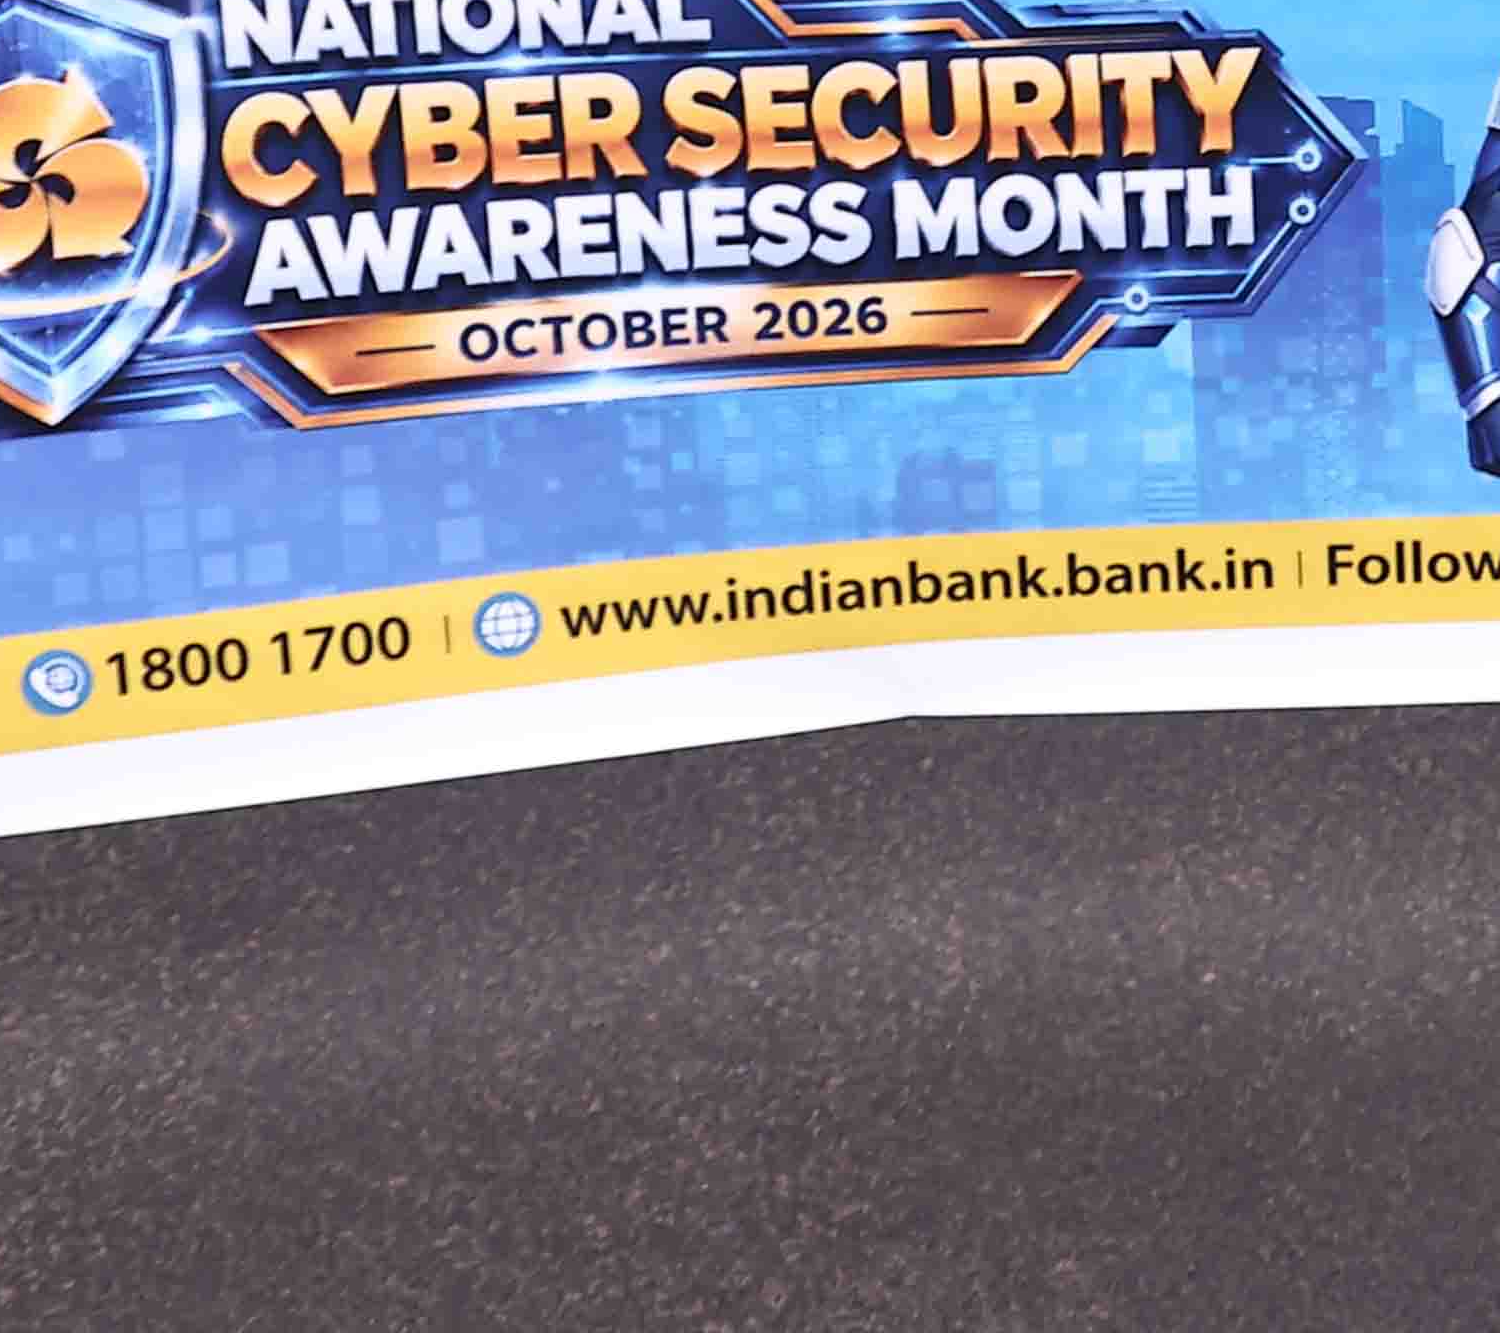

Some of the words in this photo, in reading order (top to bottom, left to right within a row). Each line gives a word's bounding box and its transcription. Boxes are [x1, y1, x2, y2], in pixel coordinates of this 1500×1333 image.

[221, 70, 647, 210] CYBER
[662, 46, 1263, 176] SECURITY
[243, 178, 873, 308] AWARENESS
[890, 164, 1258, 268] MONTH
[459, 306, 730, 362] OCTOBER
[753, 296, 888, 341] 2026
[559, 547, 1274, 638] www.indianbank.bank.in
[107, 638, 249, 696] 1800
[270, 616, 410, 675] 1700
